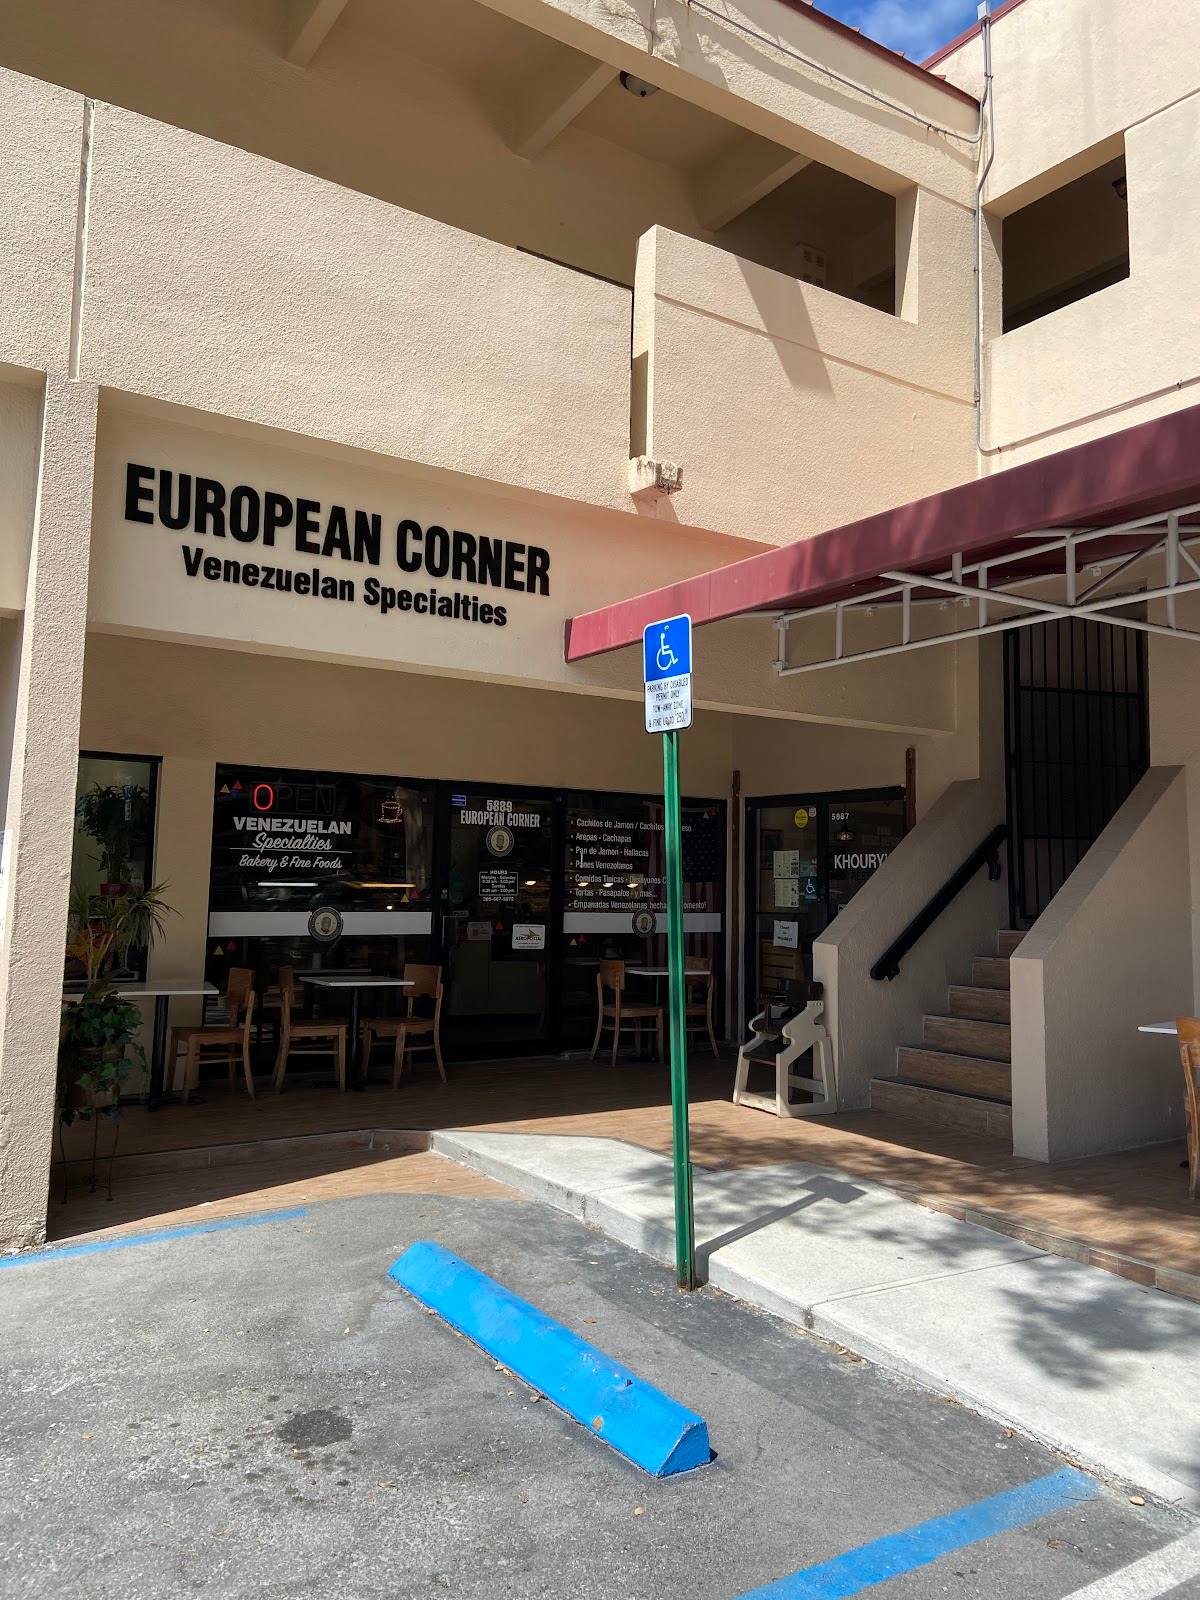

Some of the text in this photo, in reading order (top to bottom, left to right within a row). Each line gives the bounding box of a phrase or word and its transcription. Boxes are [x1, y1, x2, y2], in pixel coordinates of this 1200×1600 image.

[125, 463, 550, 596] EUROPEAN CORNER
[182, 545, 508, 627] Venezuelan Specialties
[648, 677, 688, 693] PARKING BY DISABLED
[656, 690, 680, 701] PERMIT ONLY
[653, 700, 684, 713] TOW-AWAY ZONE
[253, 783, 335, 814] OPEN
[486, 800, 513, 812] 5889
[460, 810, 540, 828] EUROPEAN CORNER
[832, 812, 850, 820] 5887
[233, 817, 352, 835] VENEZUELAN
[576, 818, 603, 828] Cachitos
[604, 820, 612, 828] de
[613, 821, 634, 829] Jamon
[252, 832, 332, 853] Specialties
[576, 833, 597, 841] Arepas
[602, 834, 632, 843] Cachapas
[576, 846, 588, 854] Pan
[624, 849, 649, 857] Hallacas
[239, 854, 343, 872] Bakery & Fine Foods
[595, 861, 633, 870] Venezolanos
[834, 853, 887, 869] KHOURY'
[575, 874, 602, 882] Comidas
[603, 875, 624, 884] Tipicas
[575, 889, 594, 897] Tortas
[599, 889, 629, 898] Pasapalos
[574, 900, 609, 909] Empanadas
[610, 900, 647, 909] Venezolanas
[684, 901, 706, 909] omento!
